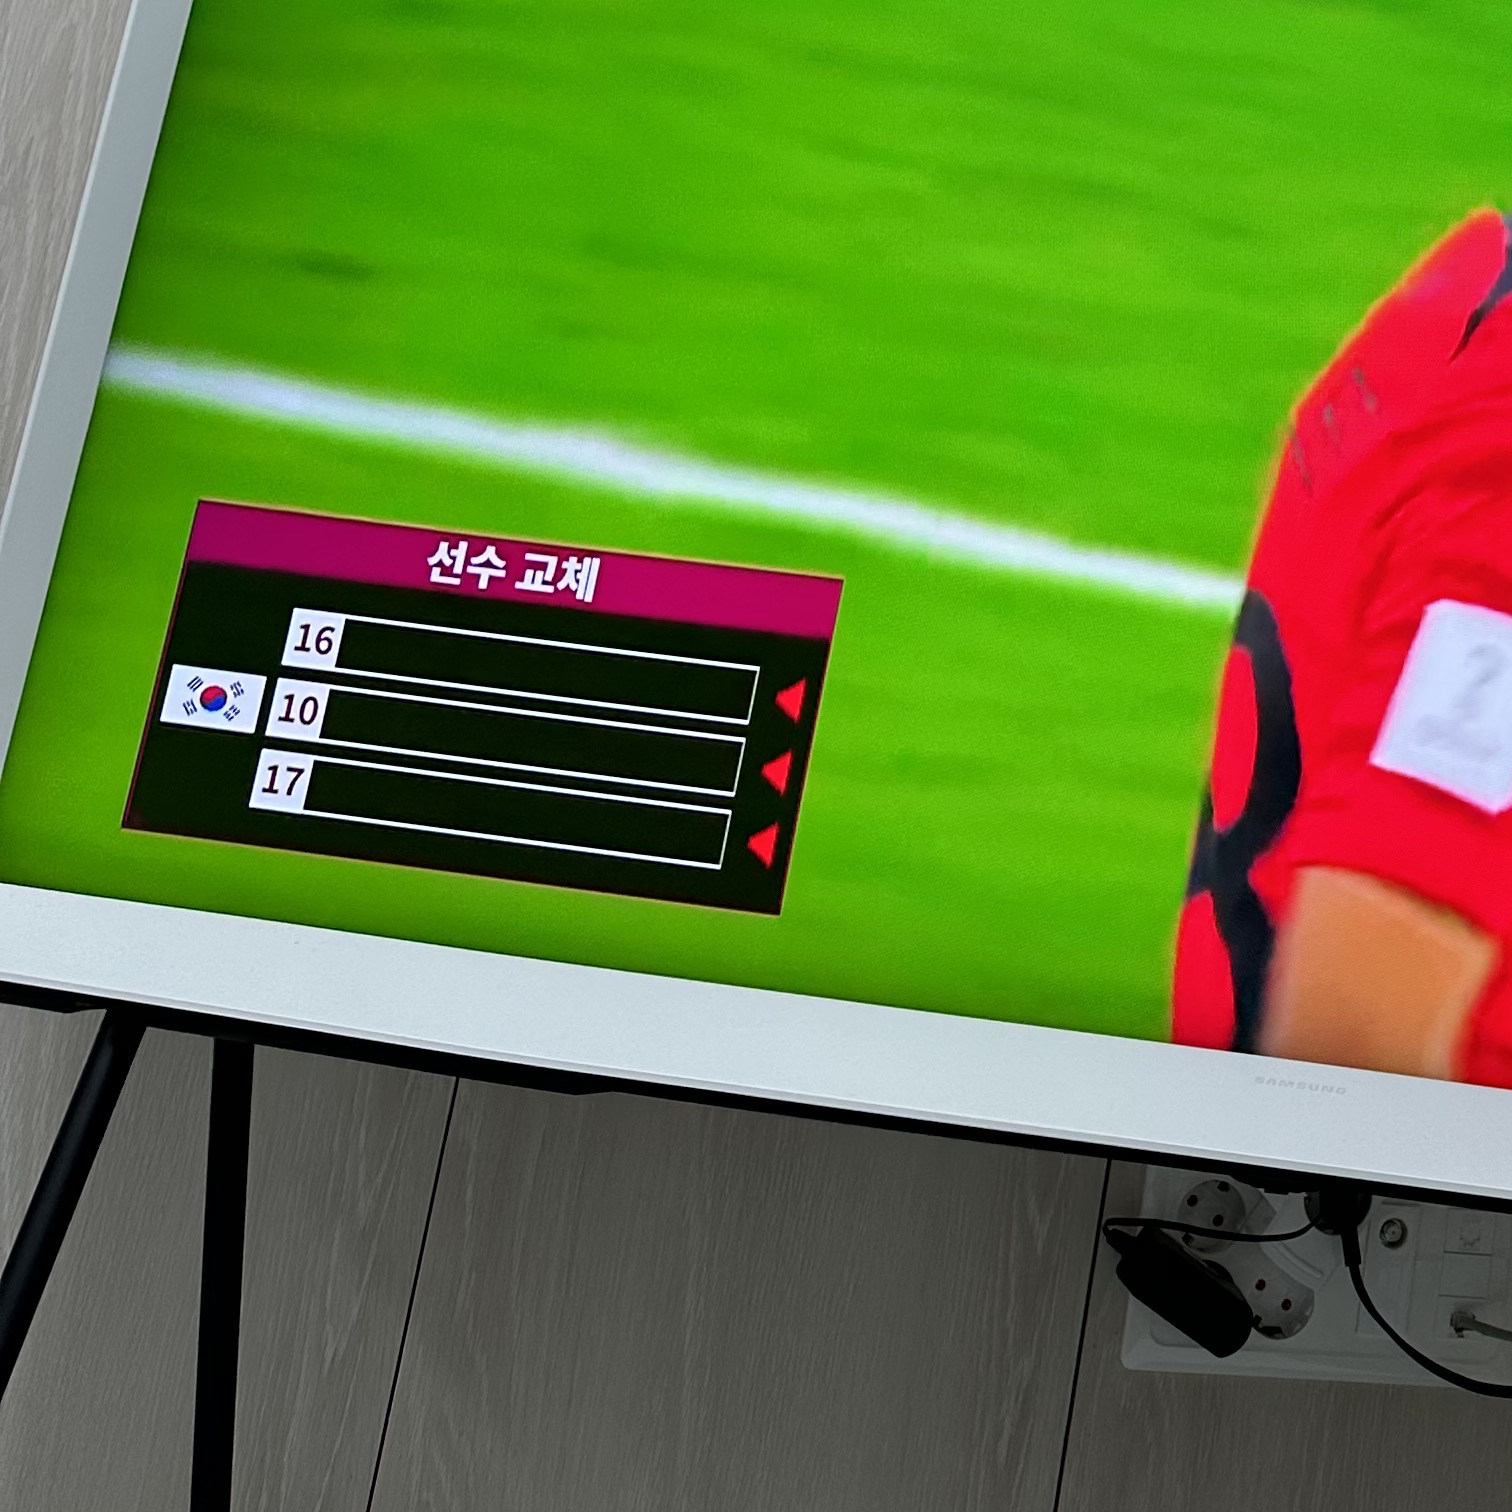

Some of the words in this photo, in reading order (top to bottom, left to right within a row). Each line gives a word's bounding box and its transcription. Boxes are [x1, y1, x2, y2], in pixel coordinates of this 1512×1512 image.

[427, 541, 506, 589] 선수
[515, 552, 601, 603] 교체
[294, 623, 335, 655] 16
[278, 693, 319, 726] 10
[262, 764, 305, 796] 17
